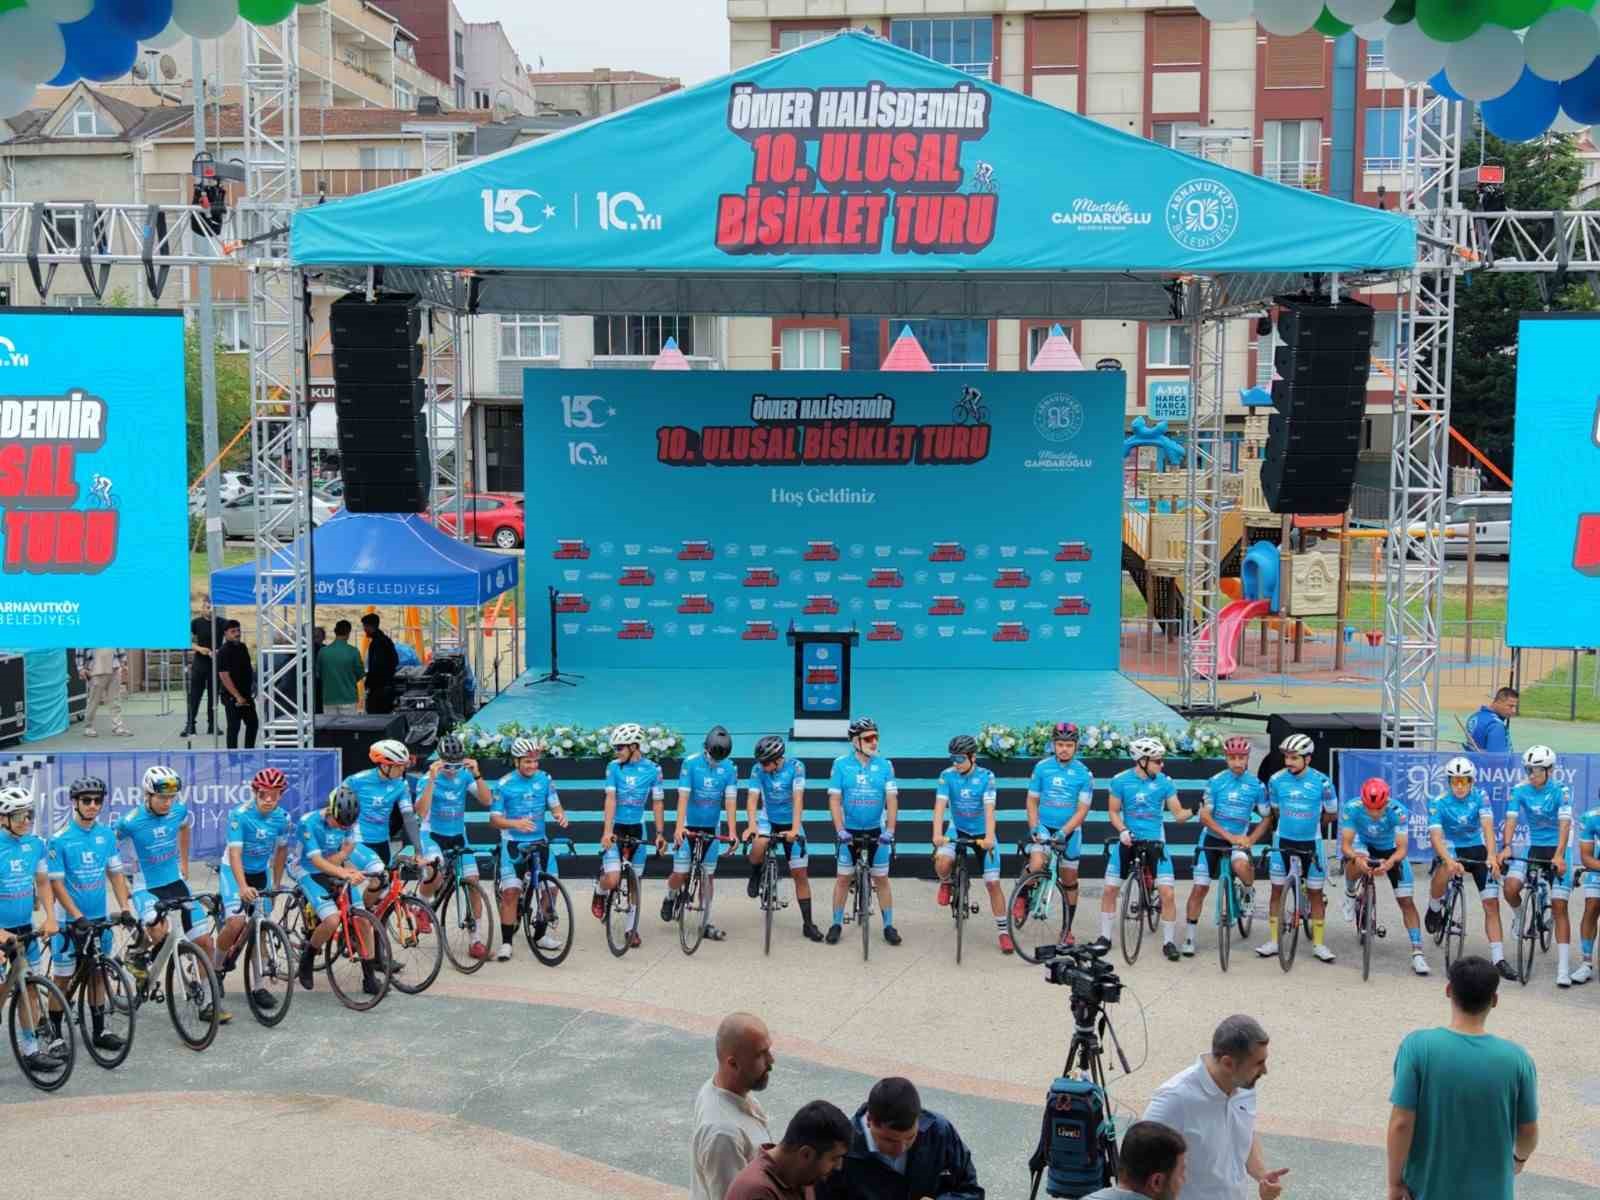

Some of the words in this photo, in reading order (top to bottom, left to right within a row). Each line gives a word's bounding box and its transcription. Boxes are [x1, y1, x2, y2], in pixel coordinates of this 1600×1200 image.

[731, 86, 813, 129] ÖMER
[819, 85, 987, 129] HALİSDEMİR
[751, 134, 808, 183] 10.
[819, 134, 961, 182] ULUSAL
[717, 187, 887, 245] BİSİKLET
[894, 195, 996, 245] TURU
[1072, 197, 1130, 215] Mustafa
[0, 393, 102, 439] DEMİR
[753, 396, 798, 420] ÖMER
[800, 395, 893, 420] HALİSDEMİR
[656, 427, 696, 461] 10.
[702, 426, 796, 460] ULUSAL
[803, 421, 916, 460] BİSİKLET
[920, 426, 989, 460] TURU
[771, 488, 804, 507] Hoş
[807, 488, 876, 504] Geldiniz
[5, 510, 117, 565] TURU
